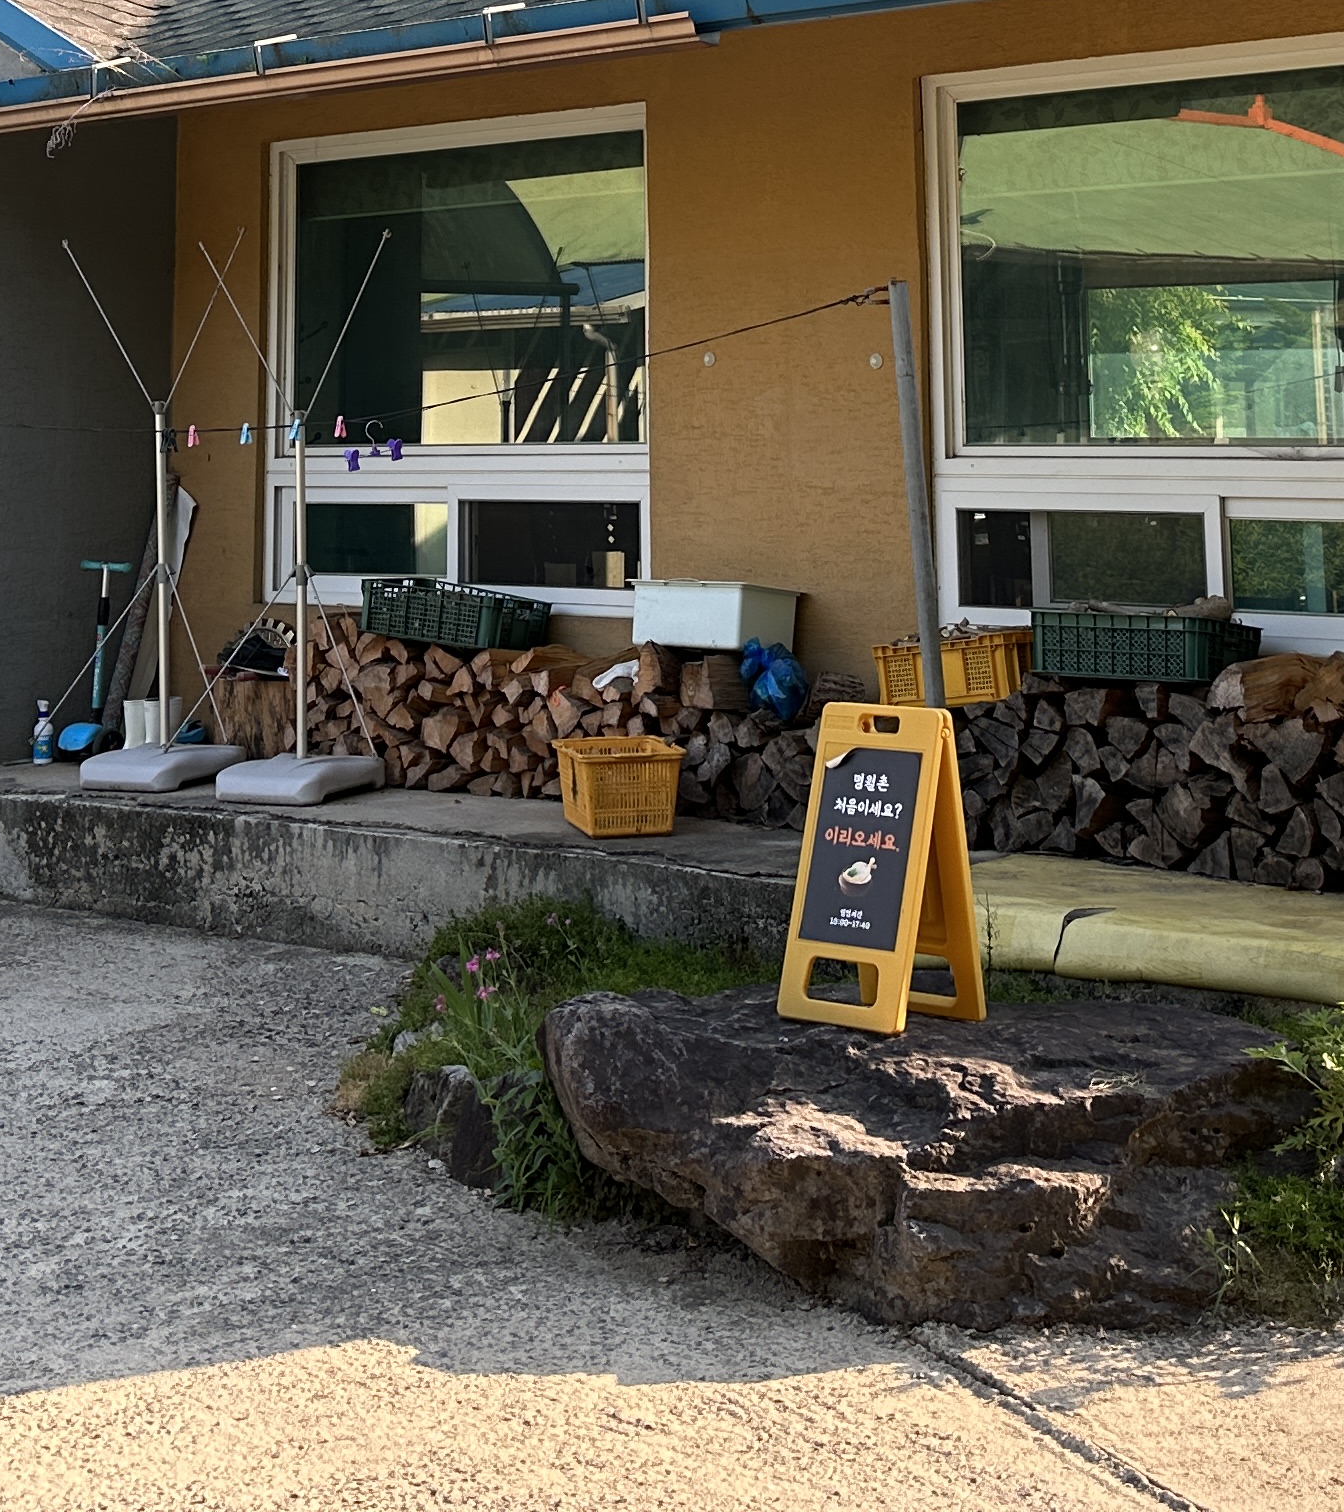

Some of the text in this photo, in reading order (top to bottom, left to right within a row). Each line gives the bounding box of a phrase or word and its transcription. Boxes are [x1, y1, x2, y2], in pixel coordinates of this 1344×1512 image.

[853, 772, 890, 792] 명월촌
[833, 796, 903, 819] 처음이세요?
[824, 826, 900, 852] 이리오세요.
